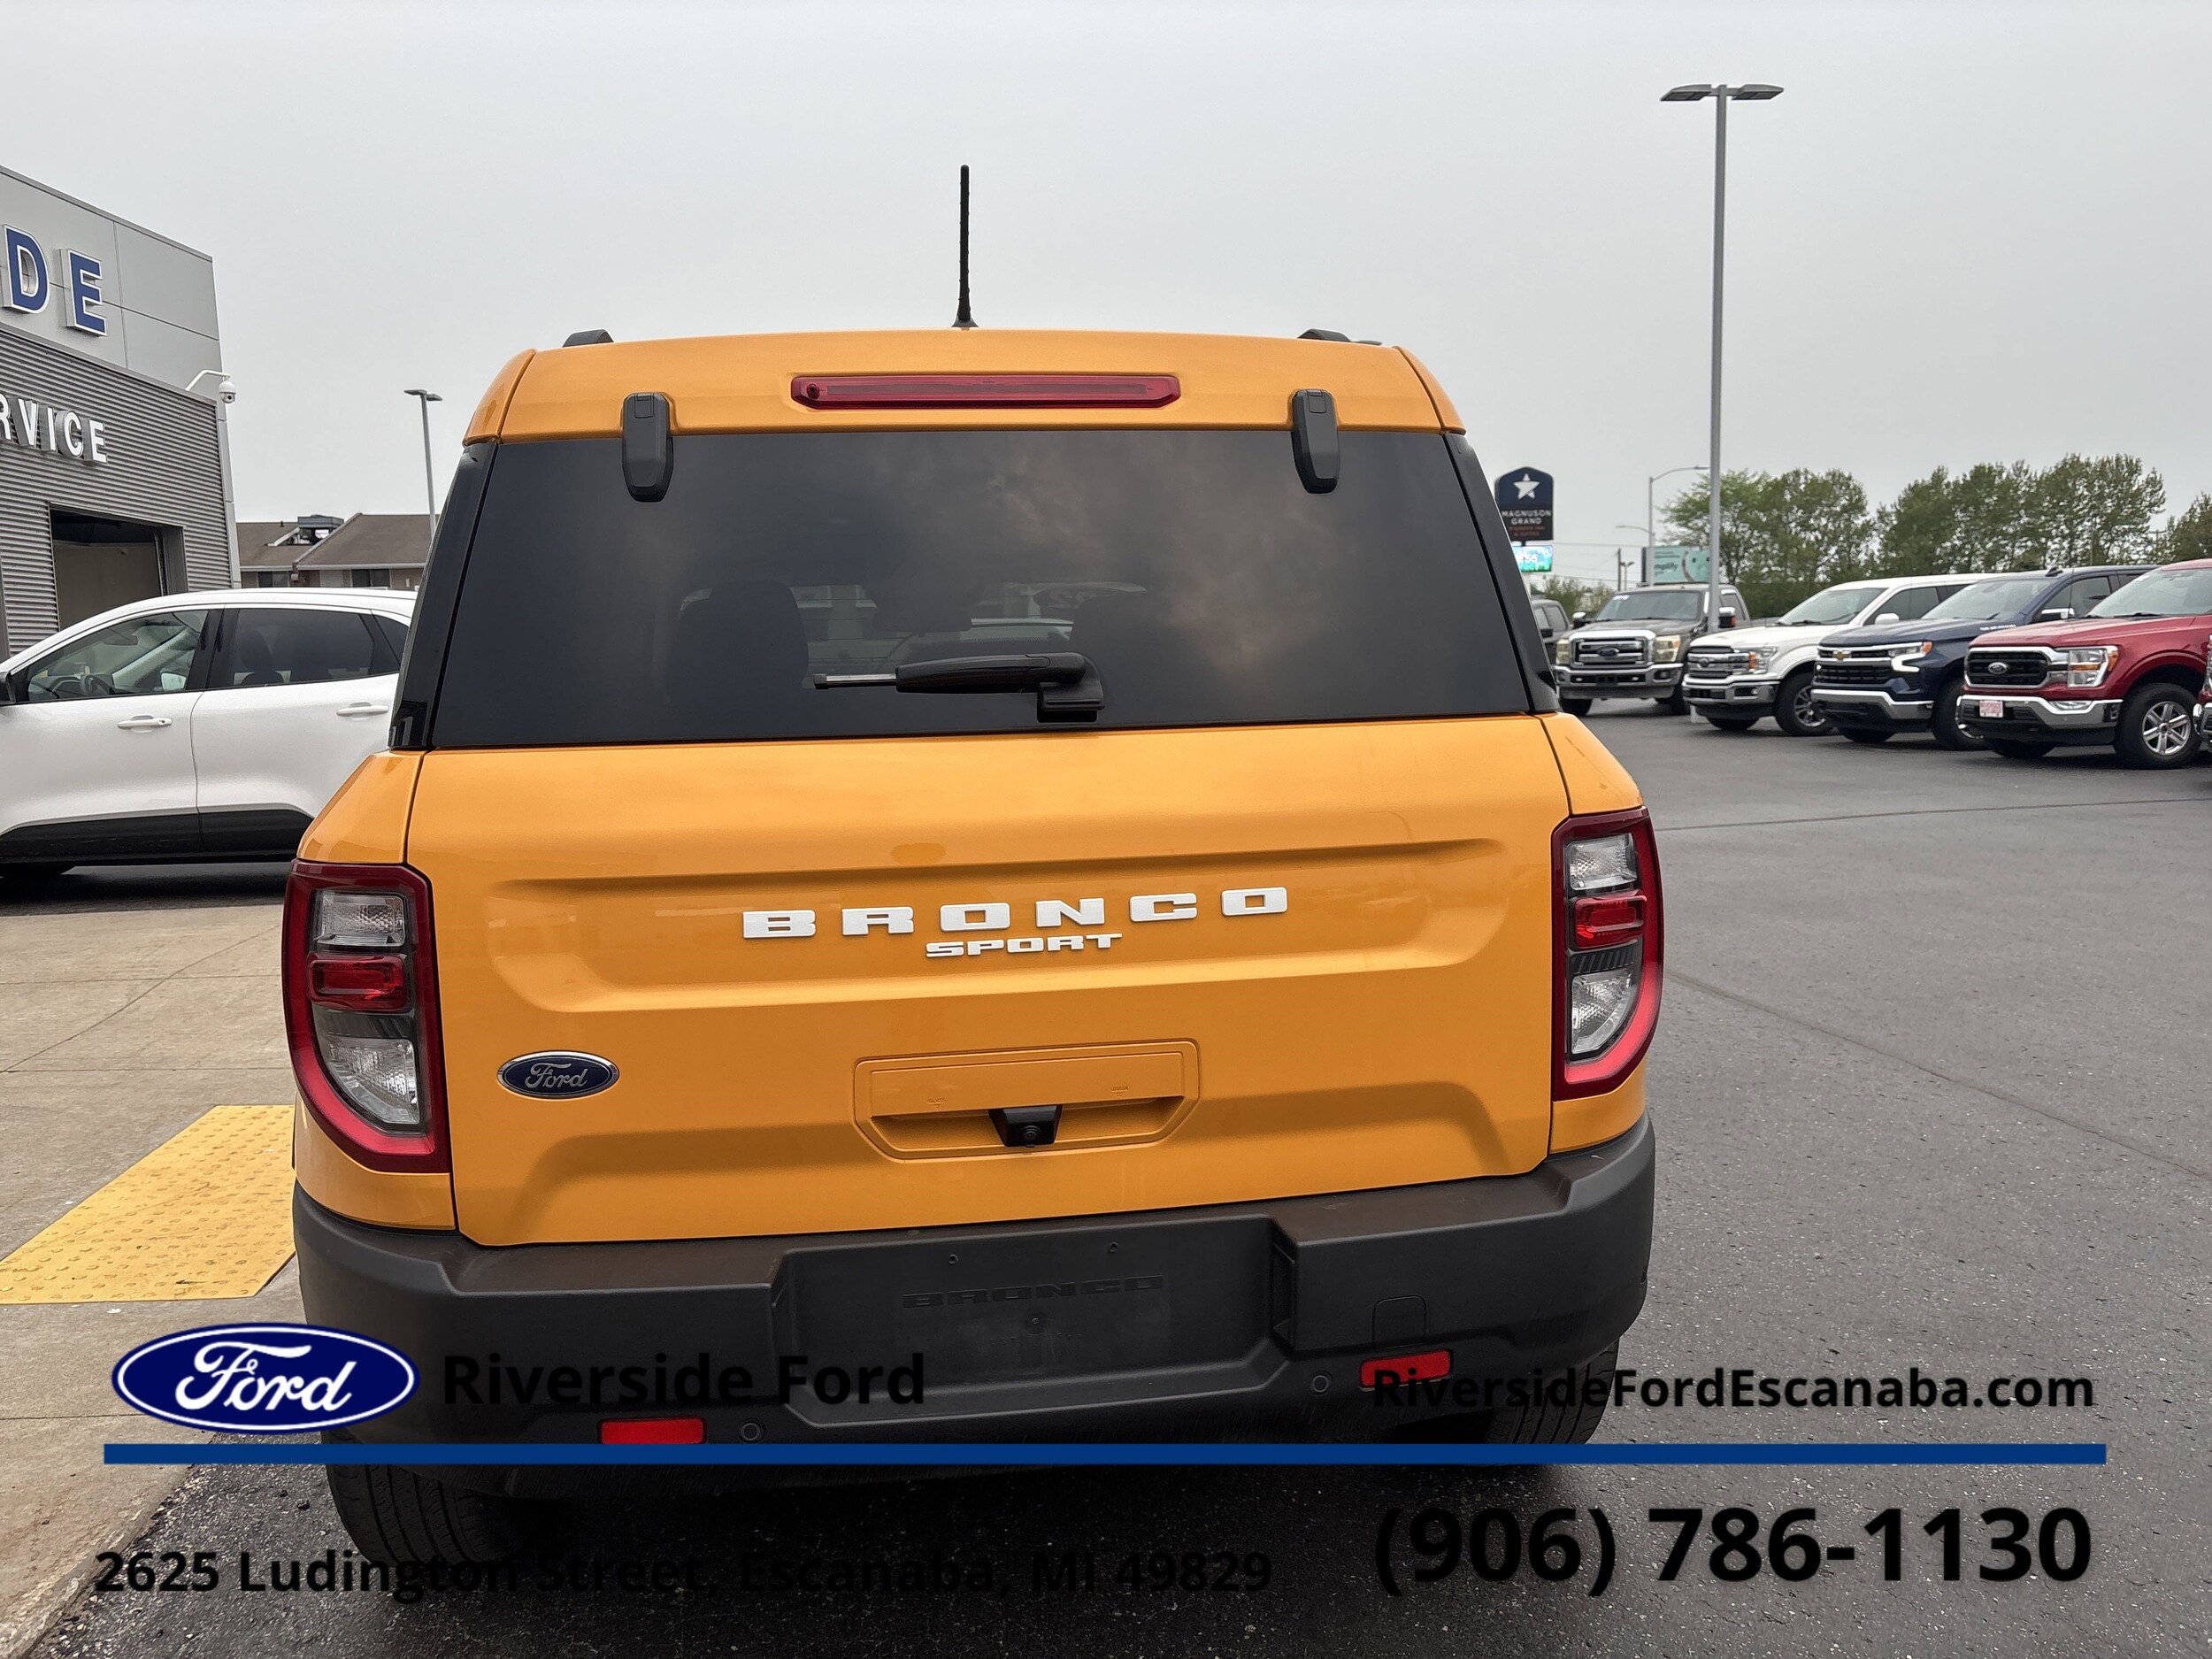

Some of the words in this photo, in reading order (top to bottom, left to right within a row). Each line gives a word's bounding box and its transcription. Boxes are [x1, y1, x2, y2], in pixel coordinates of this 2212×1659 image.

[1501, 509, 1552, 518] MAGNUSON
[1510, 517, 1542, 526] GRAND
[741, 887, 1289, 940] BRONCO
[926, 933, 1123, 958] SPORT
[524, 1062, 588, 1088] Ford
[901, 1274, 1164, 1309] BRONCO
